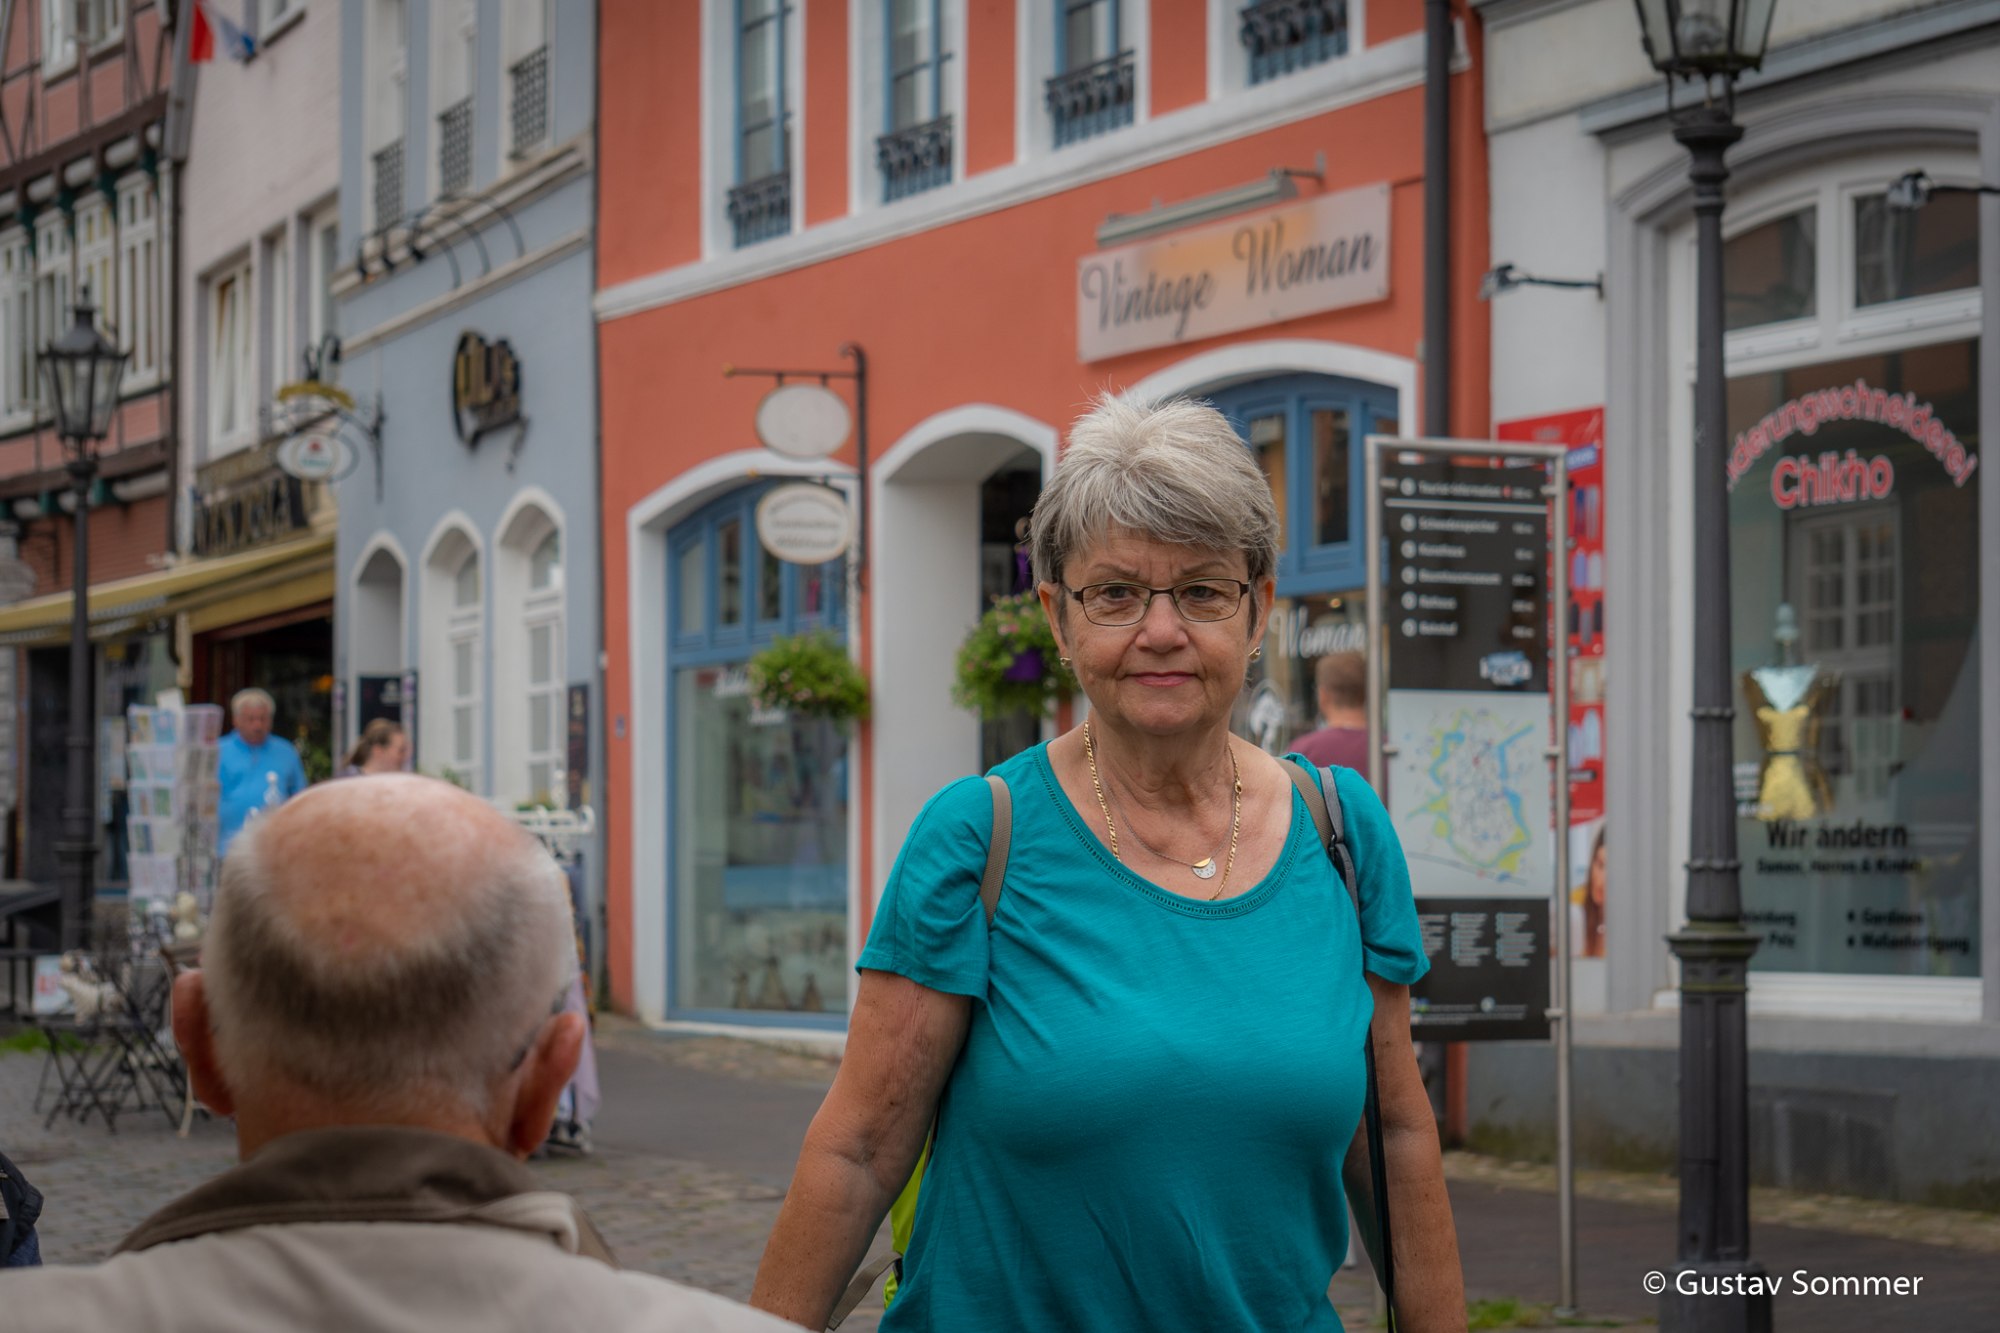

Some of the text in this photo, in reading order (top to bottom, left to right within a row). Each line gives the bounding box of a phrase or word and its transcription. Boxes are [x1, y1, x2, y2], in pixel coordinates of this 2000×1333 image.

[1081, 214, 1380, 340] Vintage Woman
[1268, 605, 1367, 658] Woman
[1767, 818, 1807, 848] Wir
